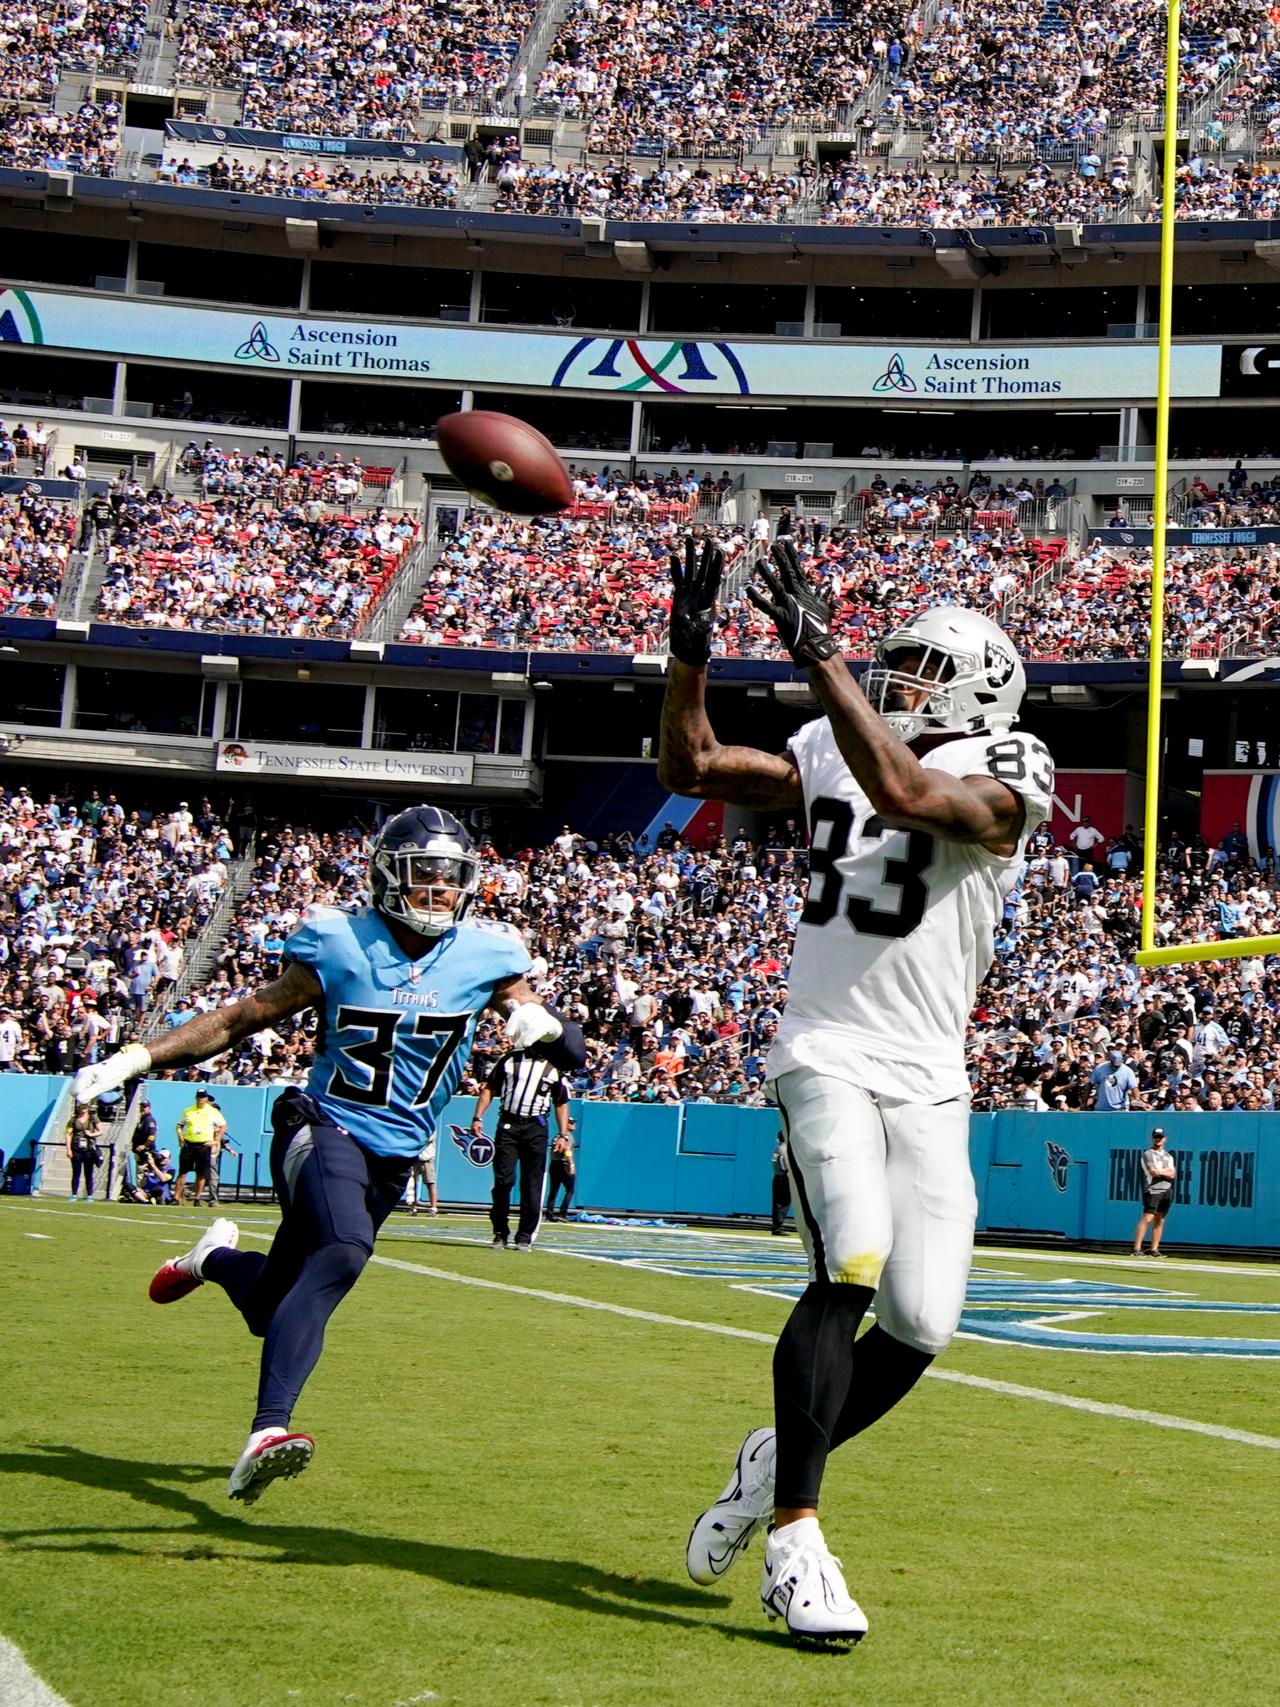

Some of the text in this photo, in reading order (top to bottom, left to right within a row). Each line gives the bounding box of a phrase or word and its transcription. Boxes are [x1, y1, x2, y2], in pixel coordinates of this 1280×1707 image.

[132, 83, 172, 96] 316-317
[290, 324, 398, 347] Ascension
[287, 346, 431, 372] Saint Thomas
[926, 353, 1030, 370] Ascension
[924, 376, 1062, 393] Saint Thomas
[1191, 531, 1257, 544] TENNESSEE TOUGH
[255, 751, 468, 778] TENNESSEE STATE UNIVERSITY
[986, 739, 1053, 796] 83
[801, 795, 934, 939] 83
[391, 985, 439, 1008] TITANS
[1063, 980, 1077, 994] 24
[605, 1008, 618, 1022] 17
[1026, 1007, 1041, 1021] 24
[325, 1004, 479, 1110] 37
[1110, 1149, 1256, 1208] TENNEE TOUGH
